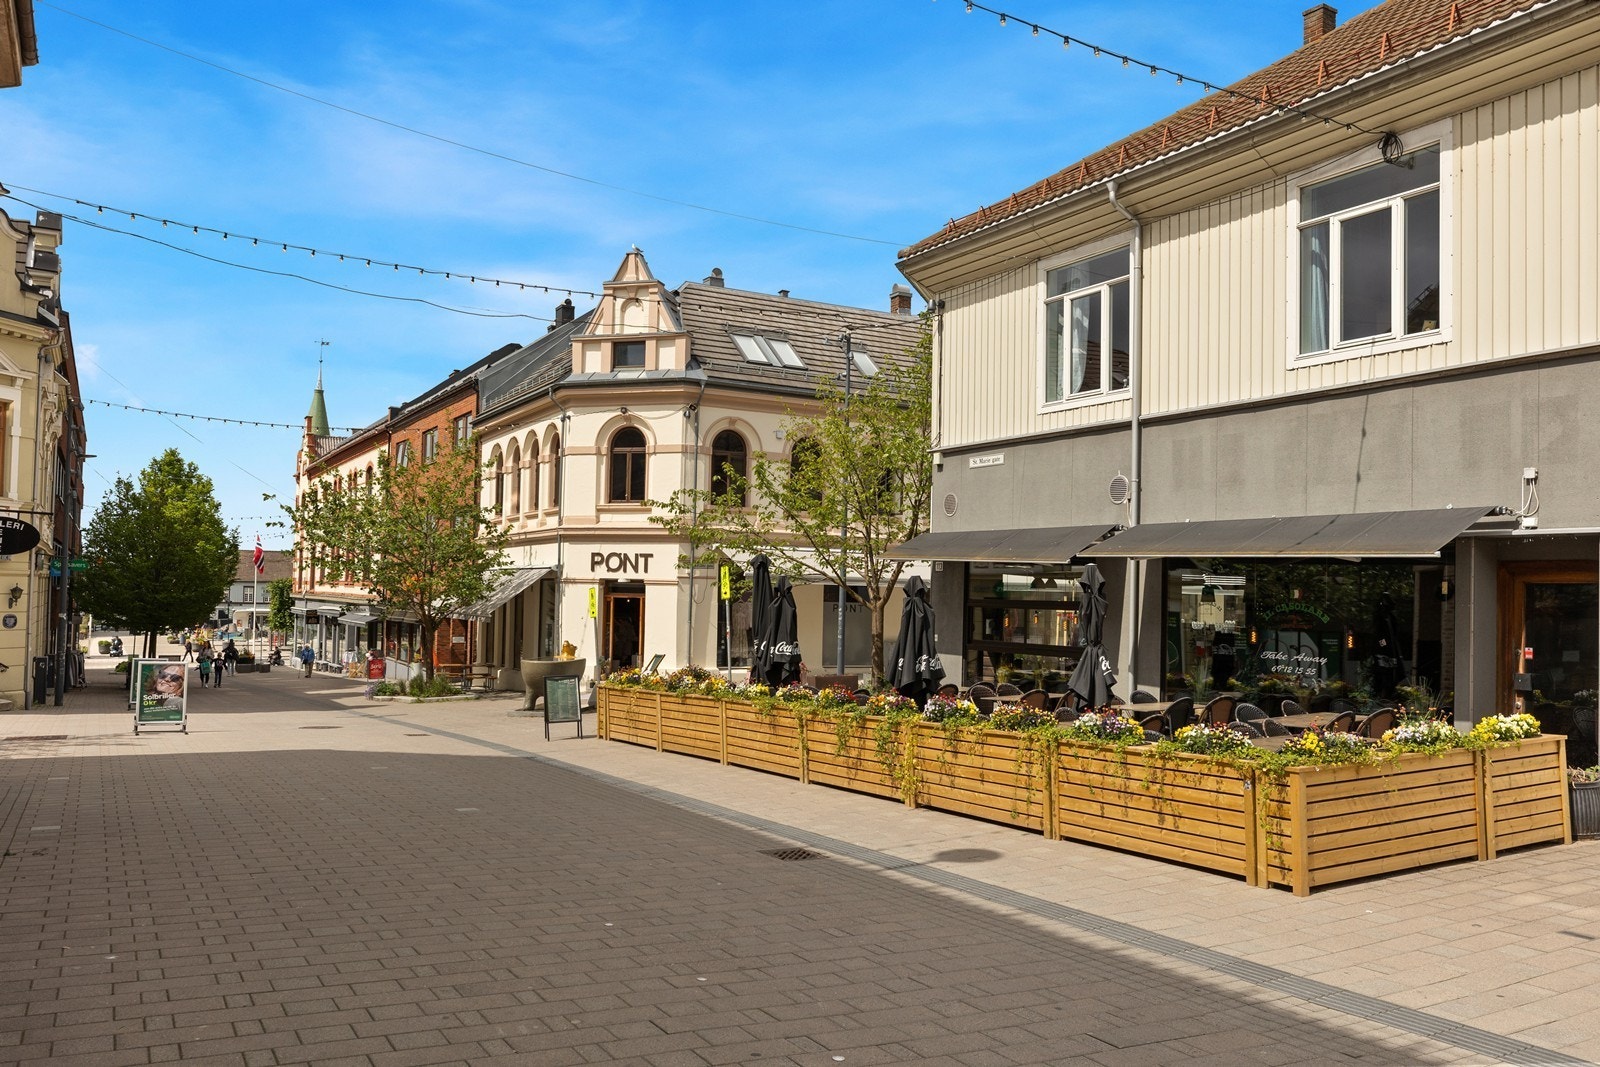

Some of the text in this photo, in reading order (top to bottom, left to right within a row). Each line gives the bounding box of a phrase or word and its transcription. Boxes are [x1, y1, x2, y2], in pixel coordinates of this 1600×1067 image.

[590, 552, 654, 574] PØNT
[832, 603, 864, 613] PNT
[1261, 651, 1328, 665] Take Away
[143, 693, 175, 701] Solbriller
